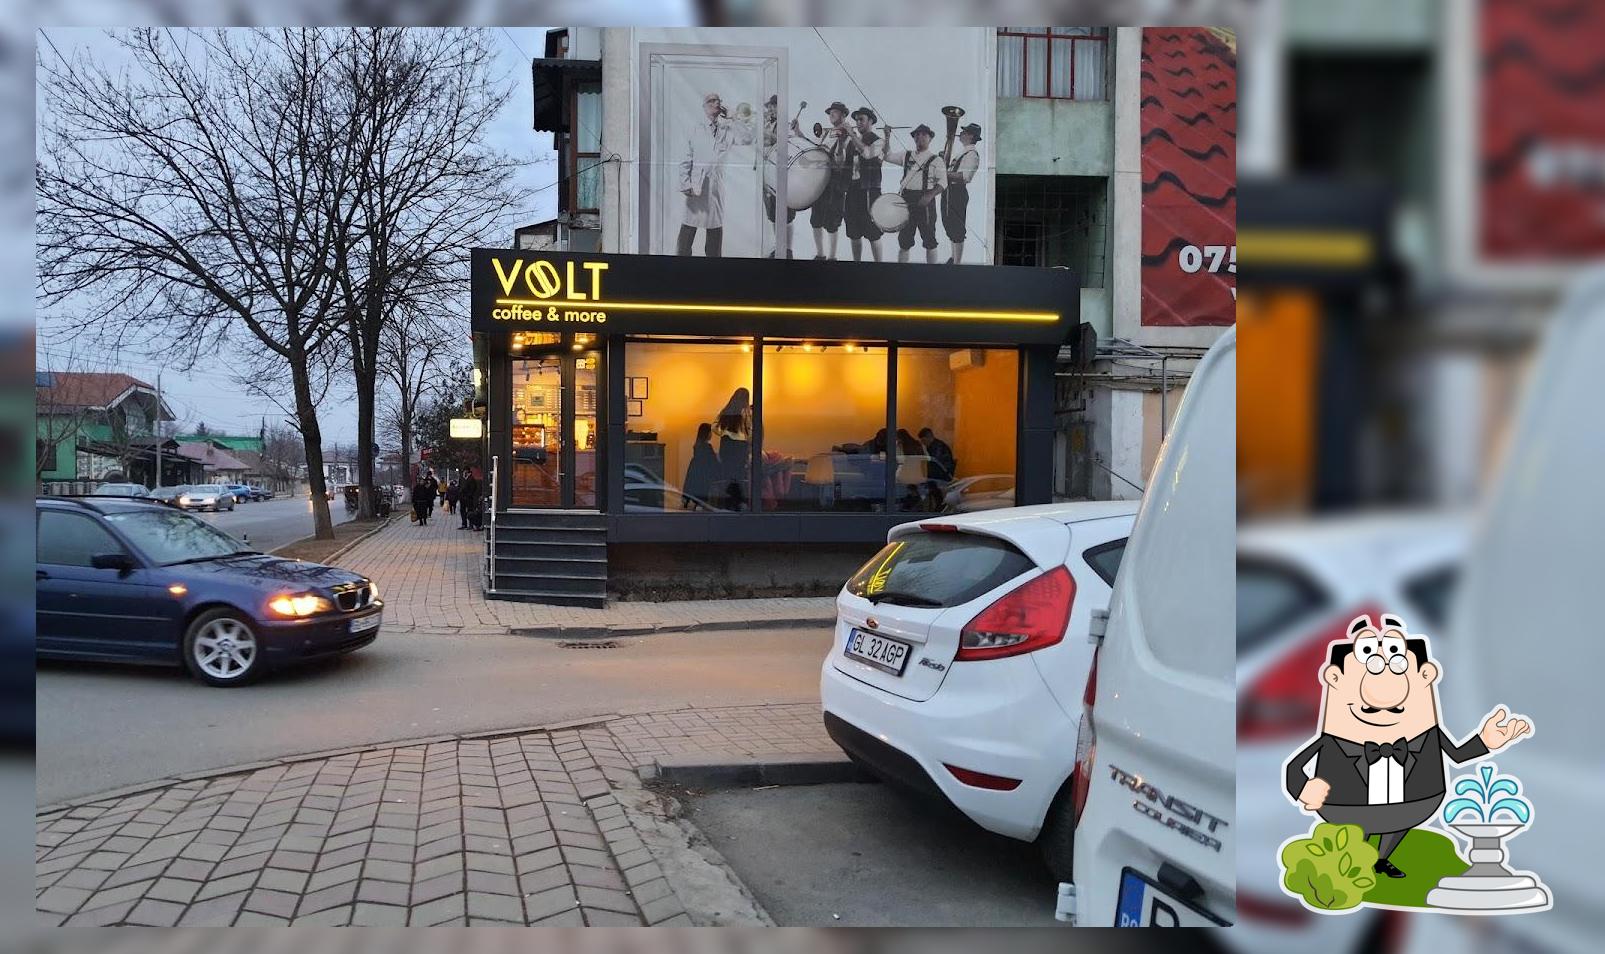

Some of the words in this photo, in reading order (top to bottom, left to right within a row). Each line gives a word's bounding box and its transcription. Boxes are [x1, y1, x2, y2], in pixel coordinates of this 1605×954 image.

[491, 258, 609, 300] VOLT
[492, 304, 542, 320] coffee
[546, 306, 560, 322] &
[564, 310, 607, 323] more
[853, 634, 865, 653] GL
[867, 638, 882, 658] 32
[879, 643, 904, 665] AGP
[1108, 763, 1229, 833] TRANSIT
